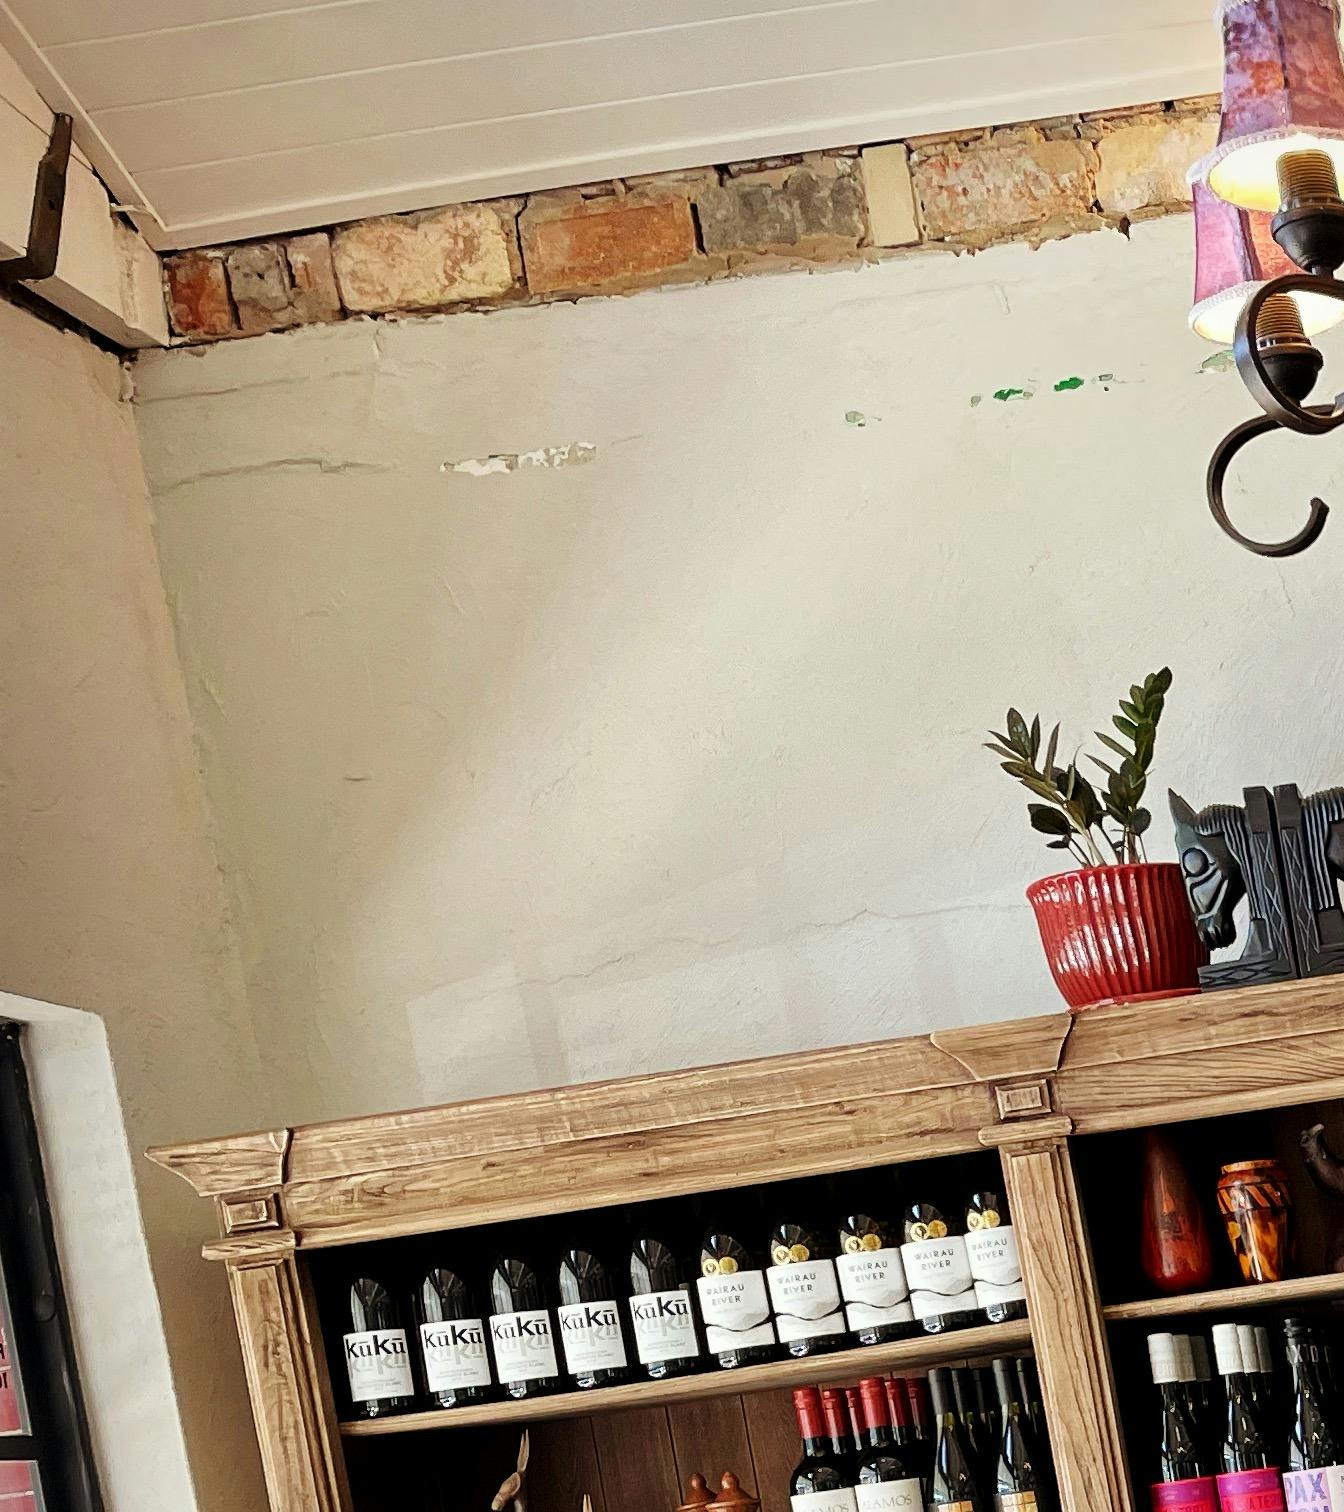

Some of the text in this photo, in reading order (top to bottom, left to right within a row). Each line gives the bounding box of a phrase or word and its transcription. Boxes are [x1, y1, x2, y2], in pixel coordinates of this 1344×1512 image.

[976, 1249, 1004, 1262] RIVER
[921, 1259, 952, 1271] RIVER
[855, 1272, 885, 1283] RIVER
[783, 1284, 813, 1296] RIVER
[711, 1295, 742, 1306] RIVER
